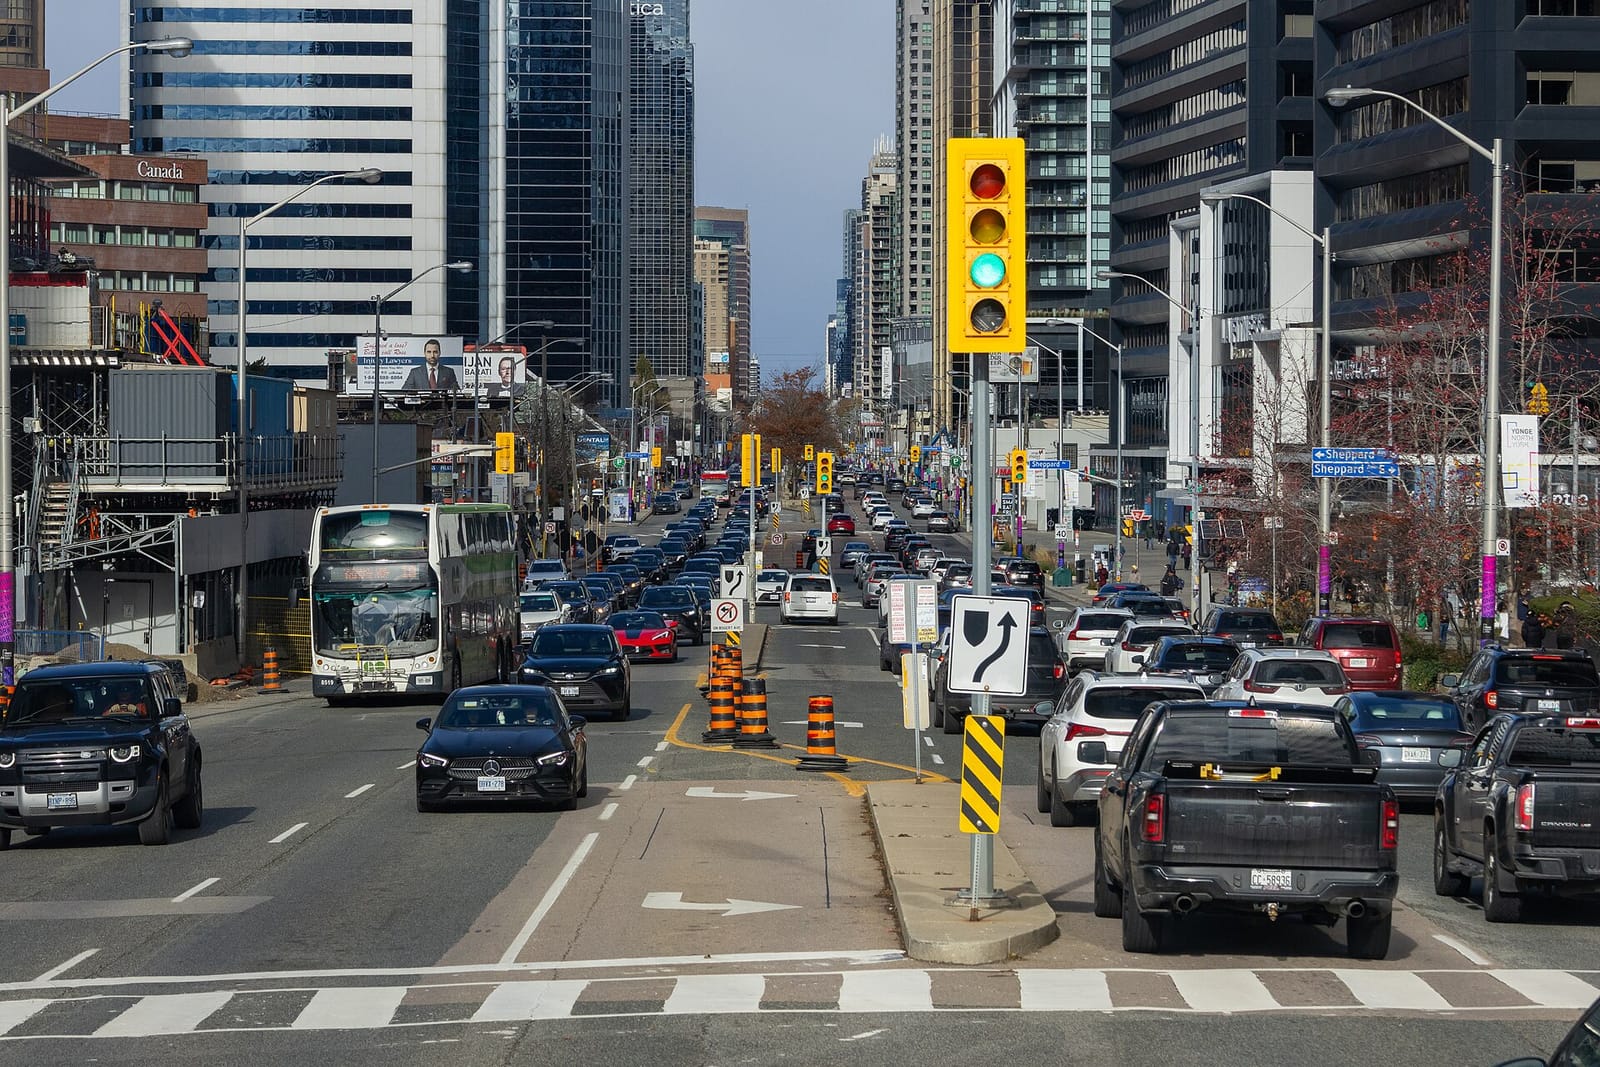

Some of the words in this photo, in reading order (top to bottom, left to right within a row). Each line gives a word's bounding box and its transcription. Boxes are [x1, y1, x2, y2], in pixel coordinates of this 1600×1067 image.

[137, 160, 183, 179] Canada
[385, 357, 412, 365] Lawyers
[1326, 449, 1375, 460] Sheppard
[1314, 463, 1364, 475] Sheppard
[1226, 813, 1322, 826] RAM
